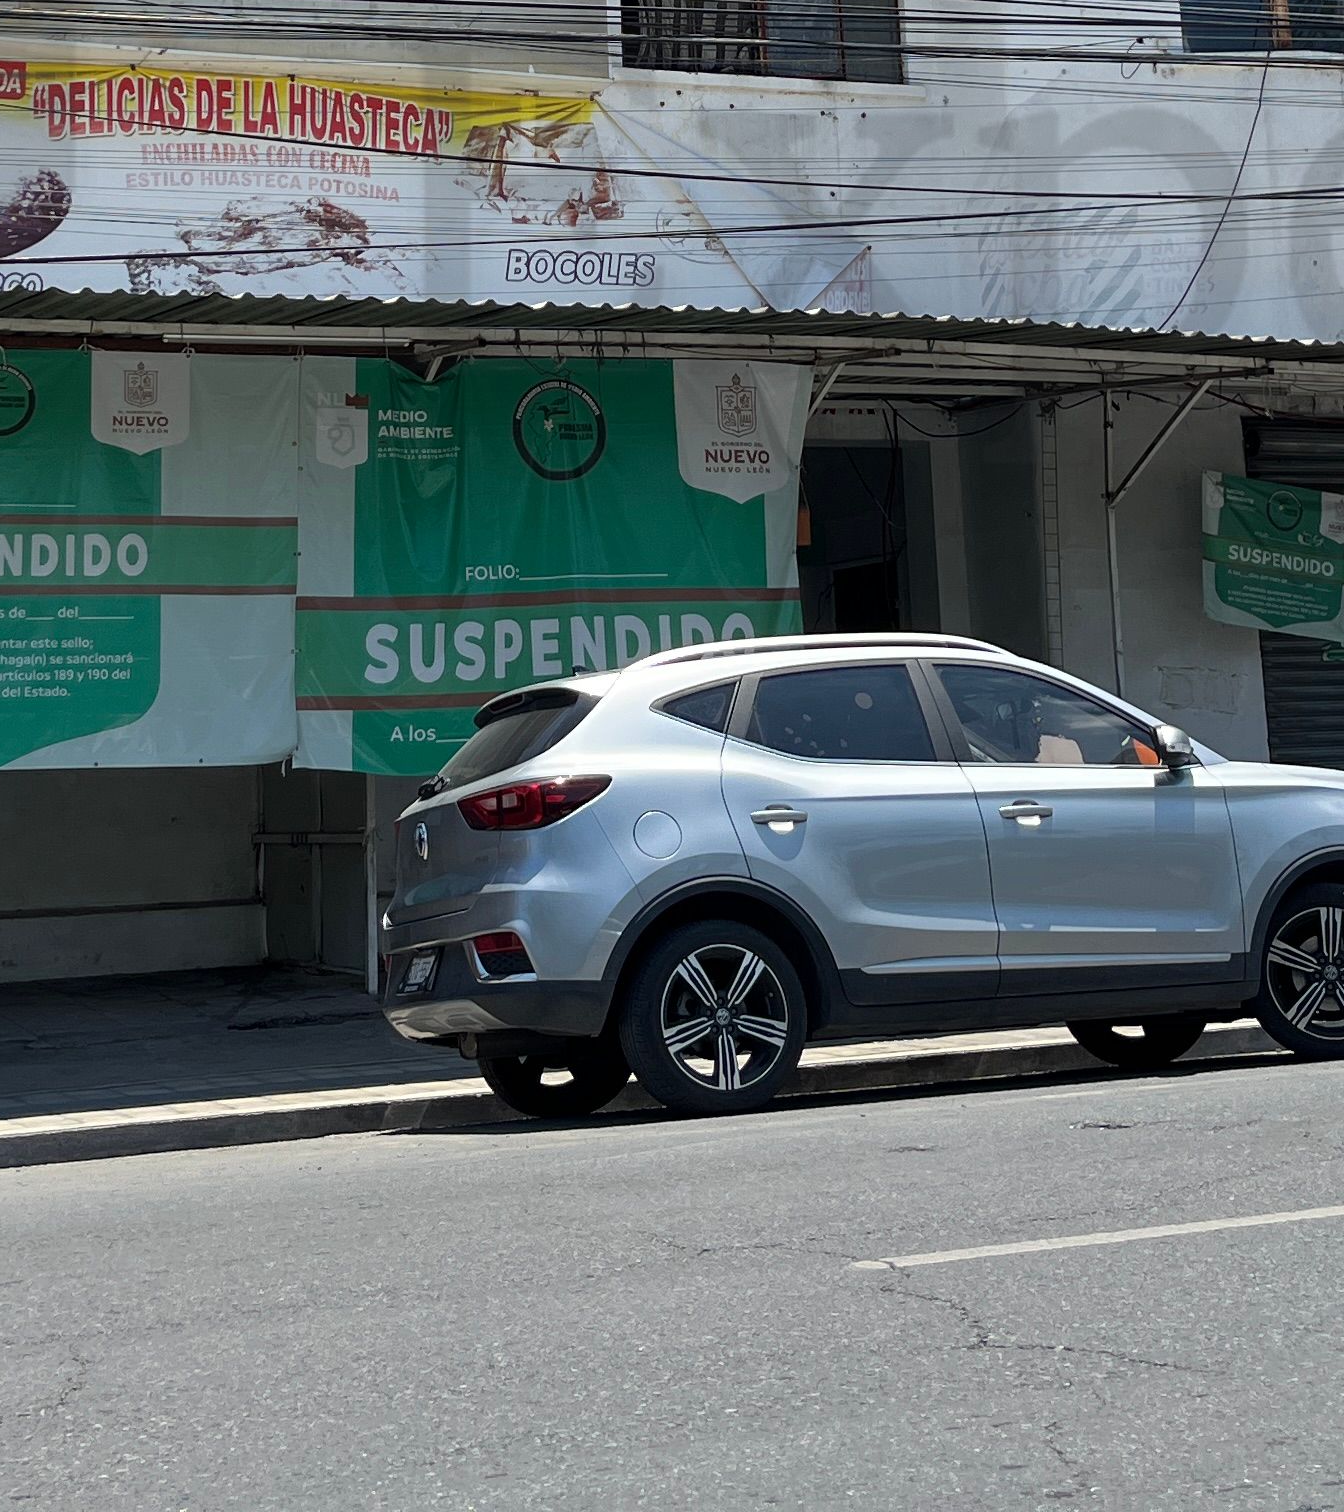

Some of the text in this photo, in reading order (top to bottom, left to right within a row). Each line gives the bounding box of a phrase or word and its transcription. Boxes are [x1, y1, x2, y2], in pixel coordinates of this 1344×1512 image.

[196, 78, 234, 134] DE
[243, 80, 280, 138] LA
[140, 142, 372, 178] ENCHILADAS CON CECINA
[126, 170, 400, 203] ESTILO HUASTECA POTOSINA
[506, 248, 655, 286] BOCOLES
[112, 416, 169, 427] NUEVO
[378, 410, 427, 423] MEDIO
[378, 426, 454, 439] AMBIENTE
[705, 449, 769, 464] NUEVO
[1228, 545, 1334, 576] SUSPENDIDO
[465, 565, 520, 581] FOLIO:
[58, 607, 79, 618] del
[30, 639, 58, 649] este
[0, 653, 47, 667] haga(n)
[49, 656, 64, 665] se
[66, 653, 134, 664] sancionará
[54, 669, 73, 681] 189
[76, 672, 84, 683] y
[87, 669, 108, 680] 190
[112, 668, 131, 680] del
[2, 687, 21, 698] del
[24, 686, 71, 698] Estado.
[391, 724, 436, 742] A los
